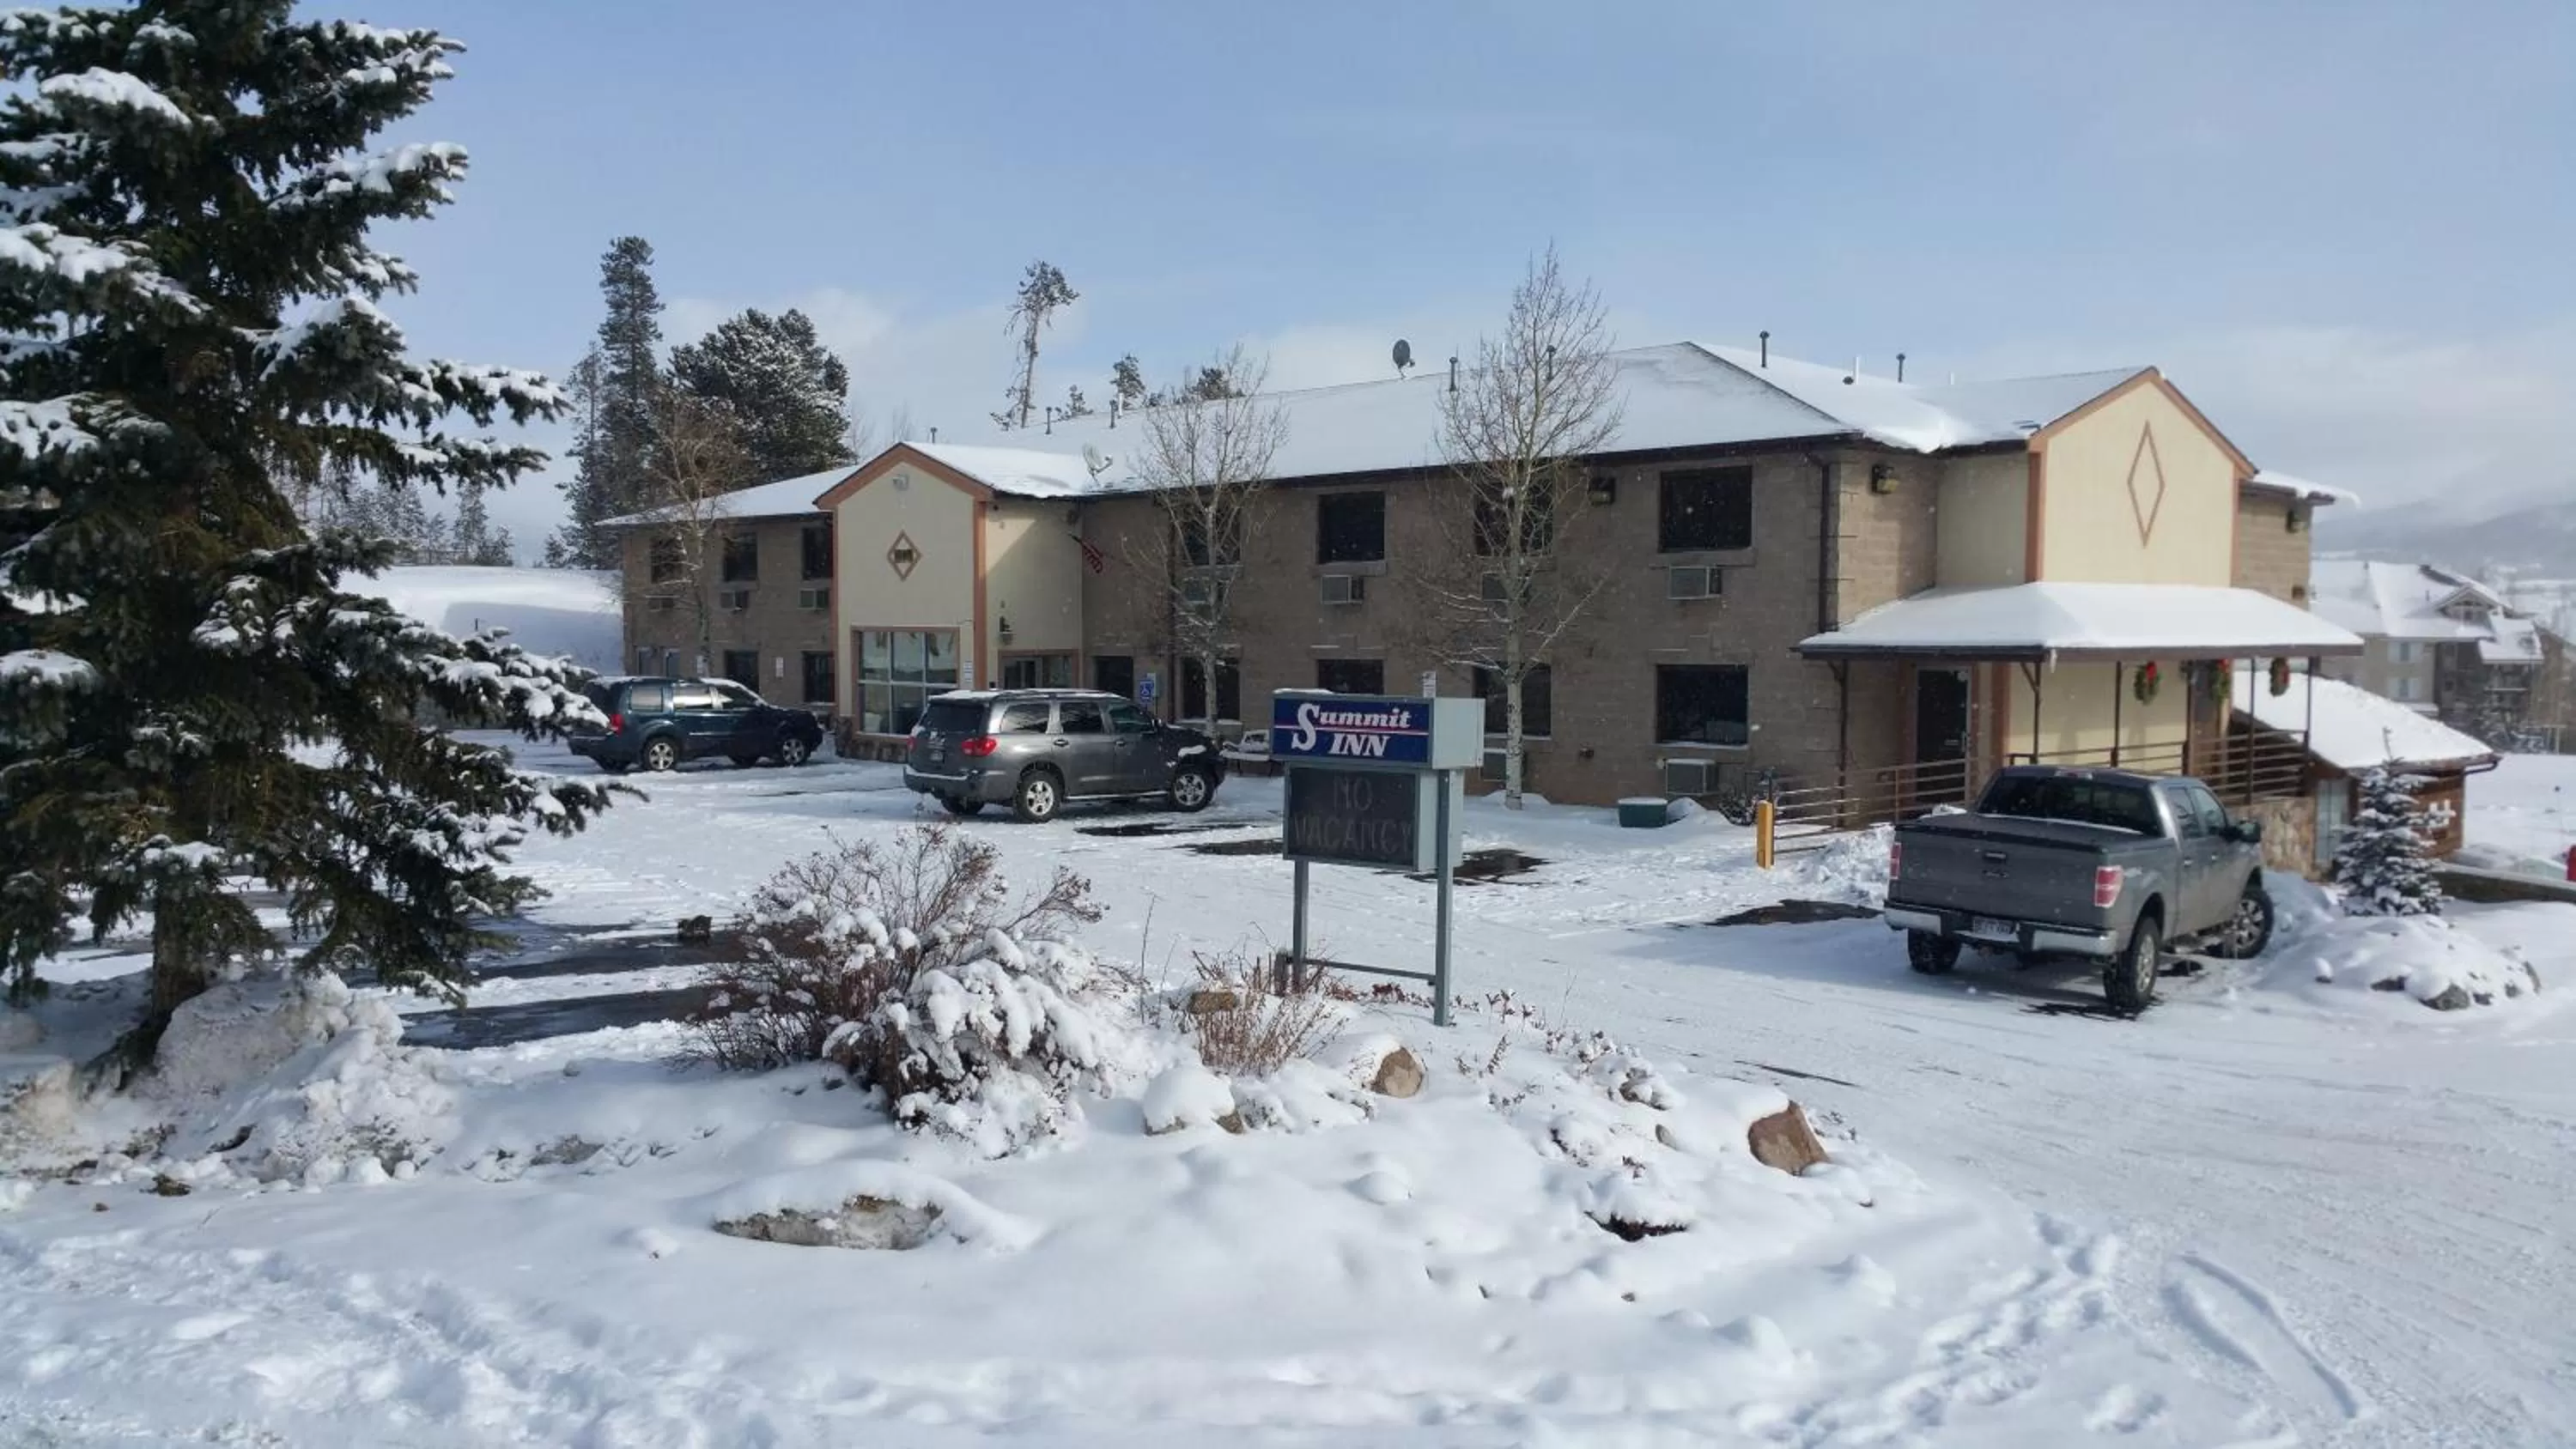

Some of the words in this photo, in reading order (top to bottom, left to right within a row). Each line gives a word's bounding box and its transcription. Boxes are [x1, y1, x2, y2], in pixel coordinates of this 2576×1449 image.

[1291, 703, 1412, 751] Summit
[1328, 733, 1390, 756] INN
[1334, 776, 1373, 811] NO
